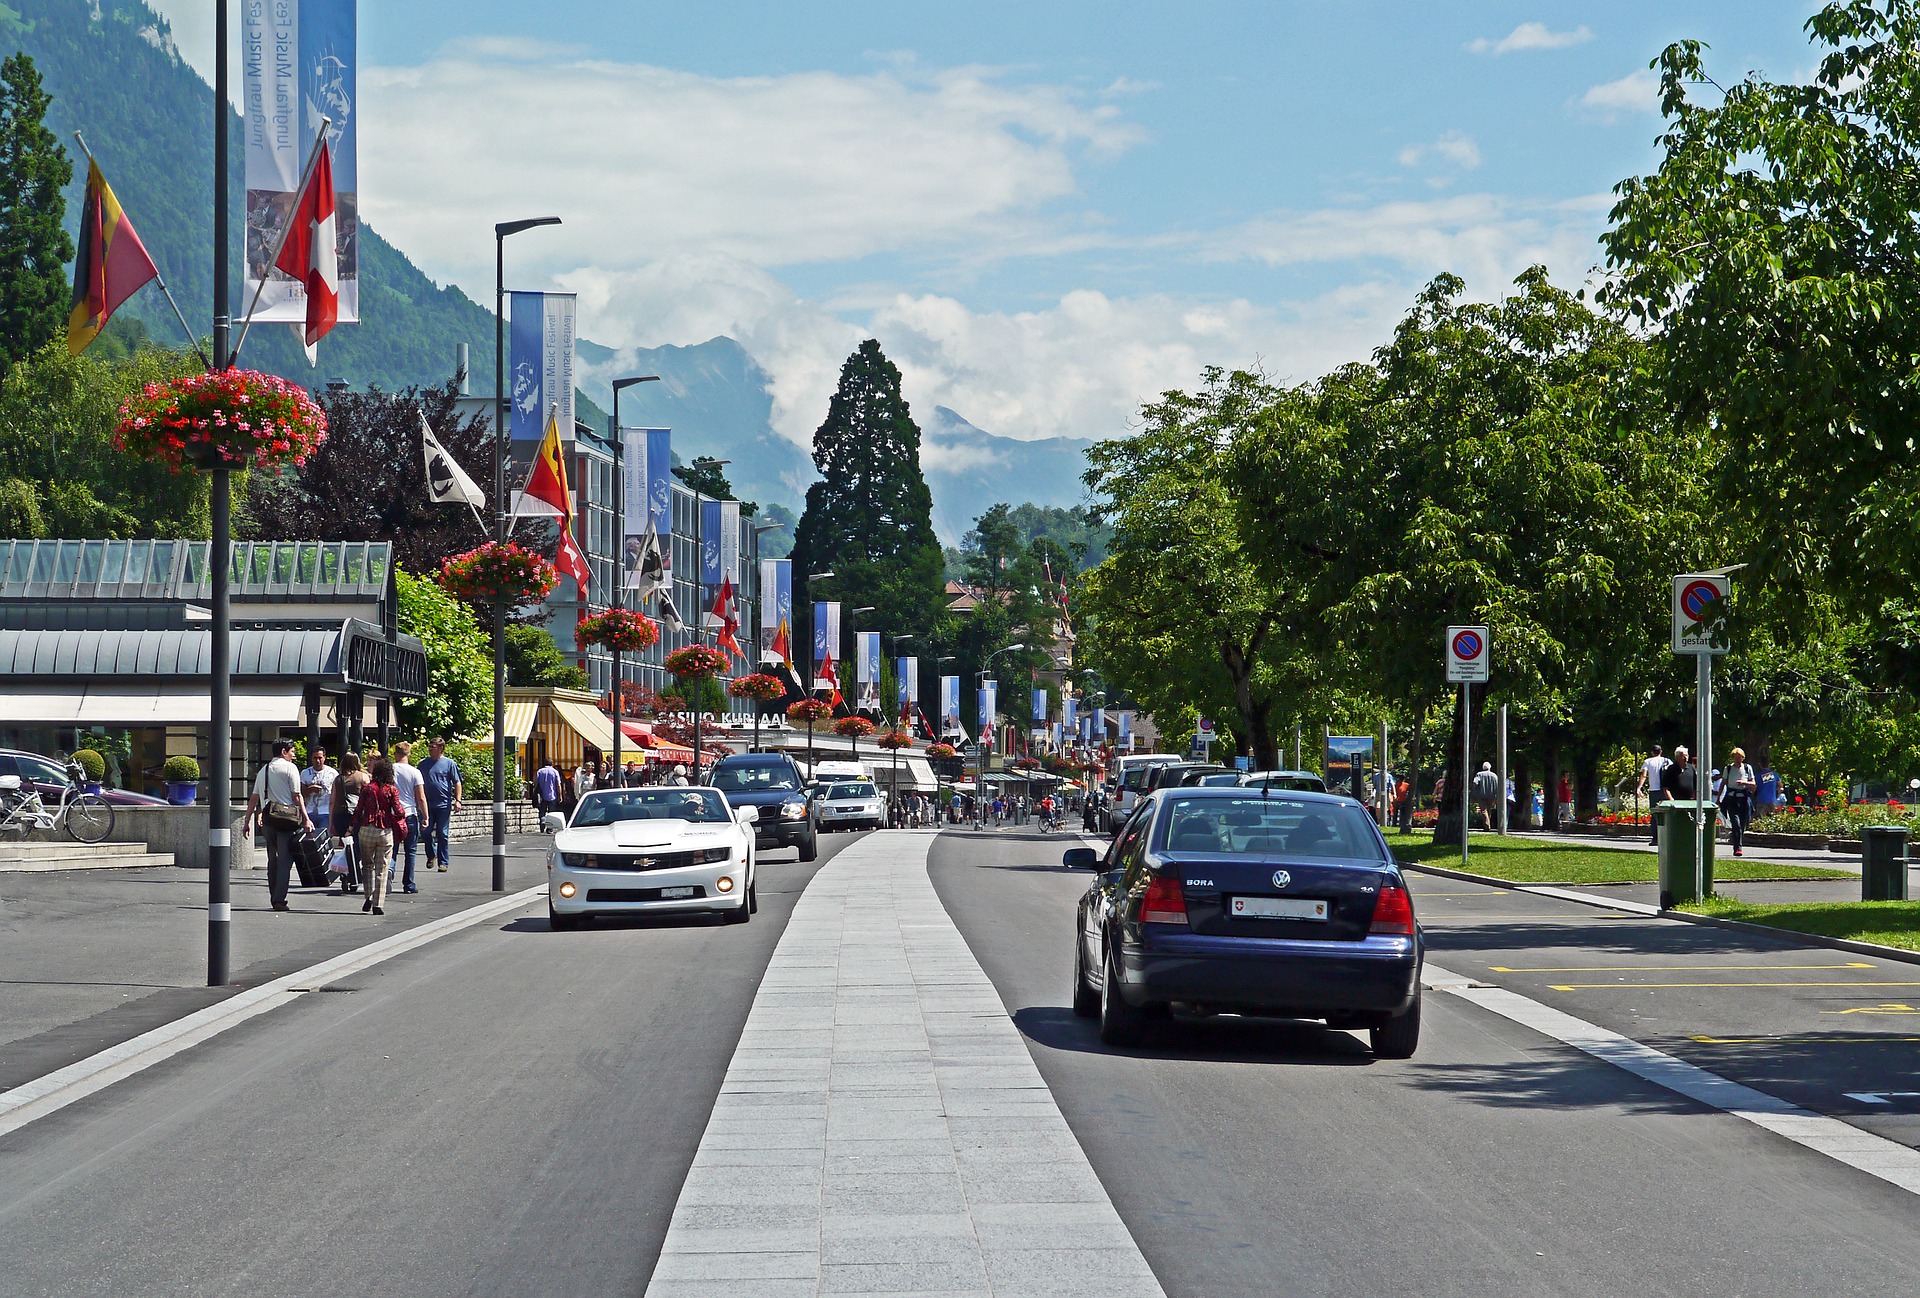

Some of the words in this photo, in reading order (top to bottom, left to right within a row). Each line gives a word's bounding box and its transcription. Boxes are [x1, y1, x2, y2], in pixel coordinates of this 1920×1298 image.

[246, 0, 262, 26] Fes
[246, 31, 262, 77] Music
[248, 83, 267, 150] Jungfrau
[546, 315, 556, 348] Festival
[546, 351, 556, 377] Music
[1681, 637, 1713, 647] gestat
[1186, 879, 1214, 887] BORA
